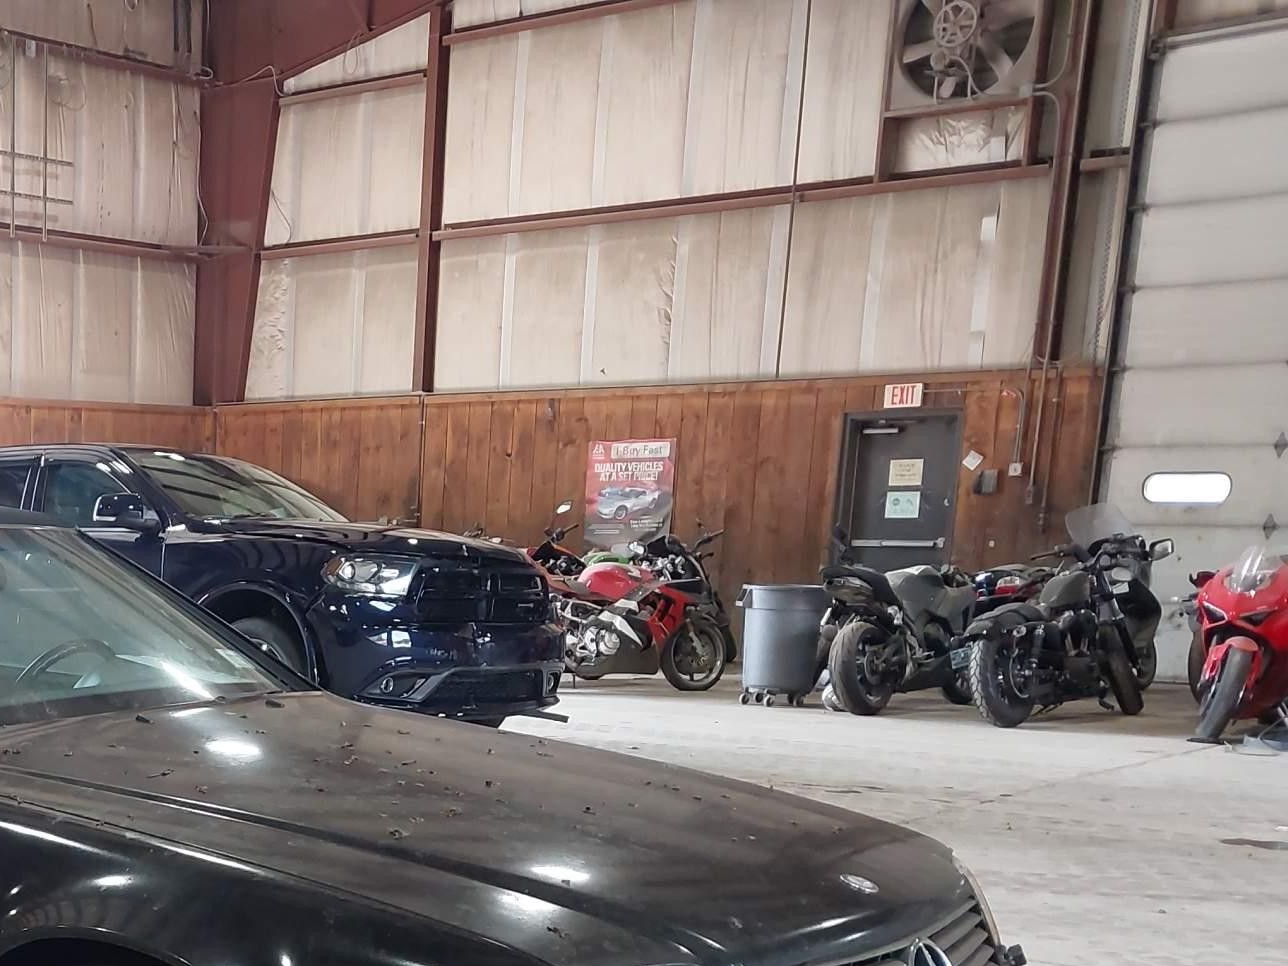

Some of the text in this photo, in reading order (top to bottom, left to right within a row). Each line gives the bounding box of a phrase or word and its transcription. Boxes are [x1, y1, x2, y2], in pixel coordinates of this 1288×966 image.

[891, 385, 917, 406] EXIT
[643, 444, 662, 455] Fast
[594, 461, 664, 472] QUALITY VEHICLES
[600, 472, 610, 481] AT
[618, 472, 633, 481] SET
